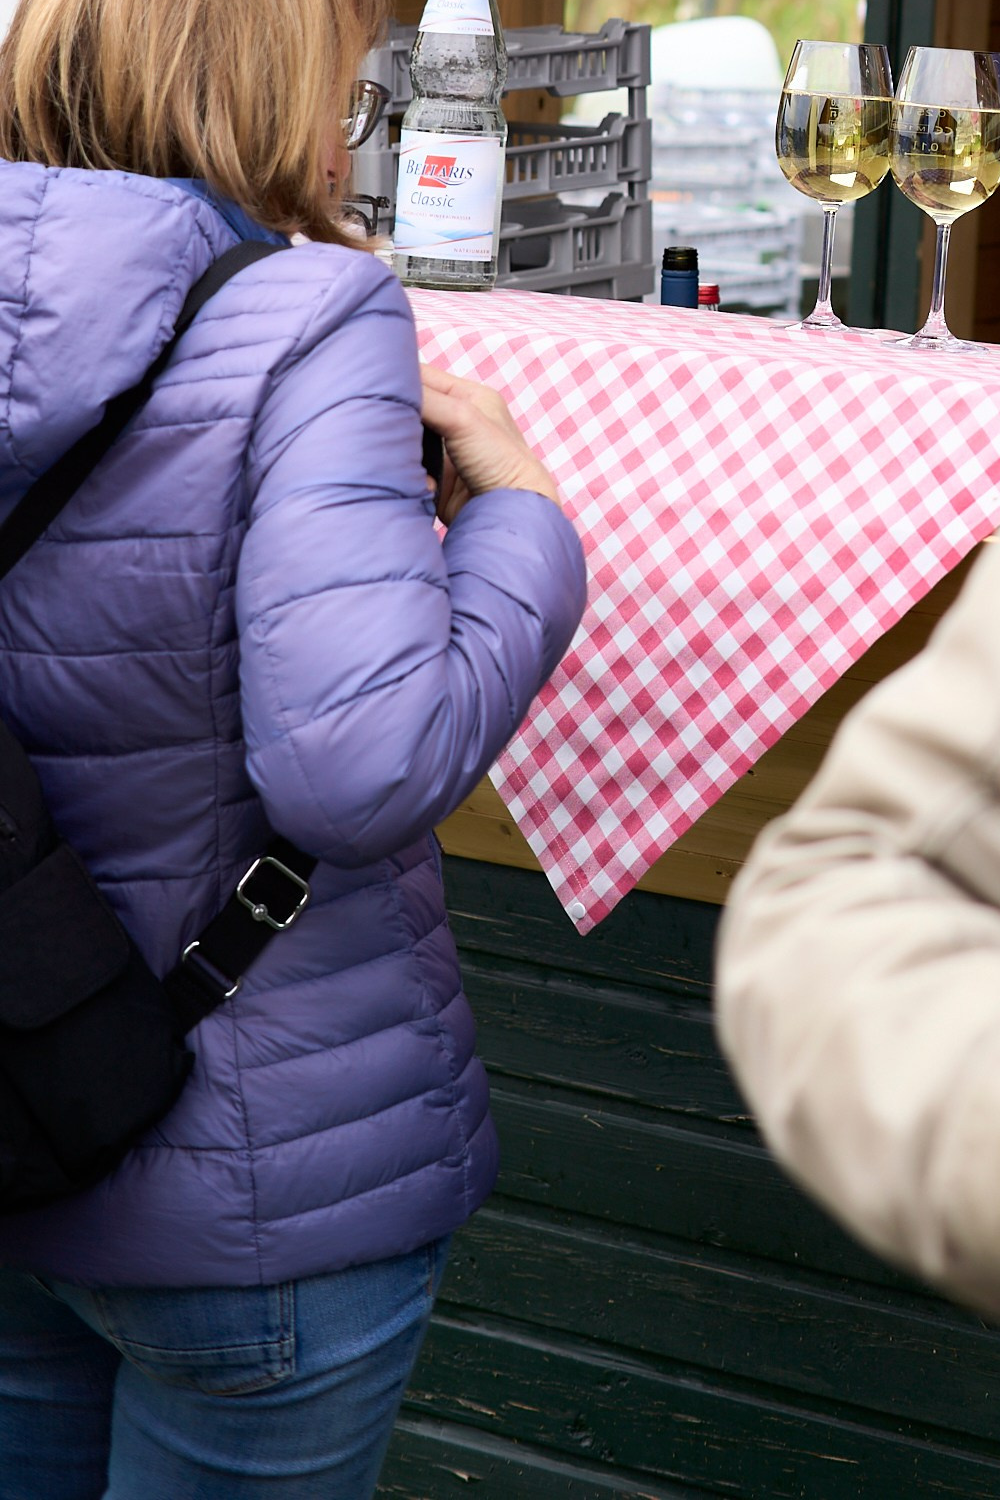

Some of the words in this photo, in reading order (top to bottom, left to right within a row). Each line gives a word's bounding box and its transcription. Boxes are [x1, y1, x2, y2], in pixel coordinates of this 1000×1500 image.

[437, 0, 465, 10] Classic
[406, 159, 475, 180] BELLARIS
[410, 191, 456, 208] Classic
